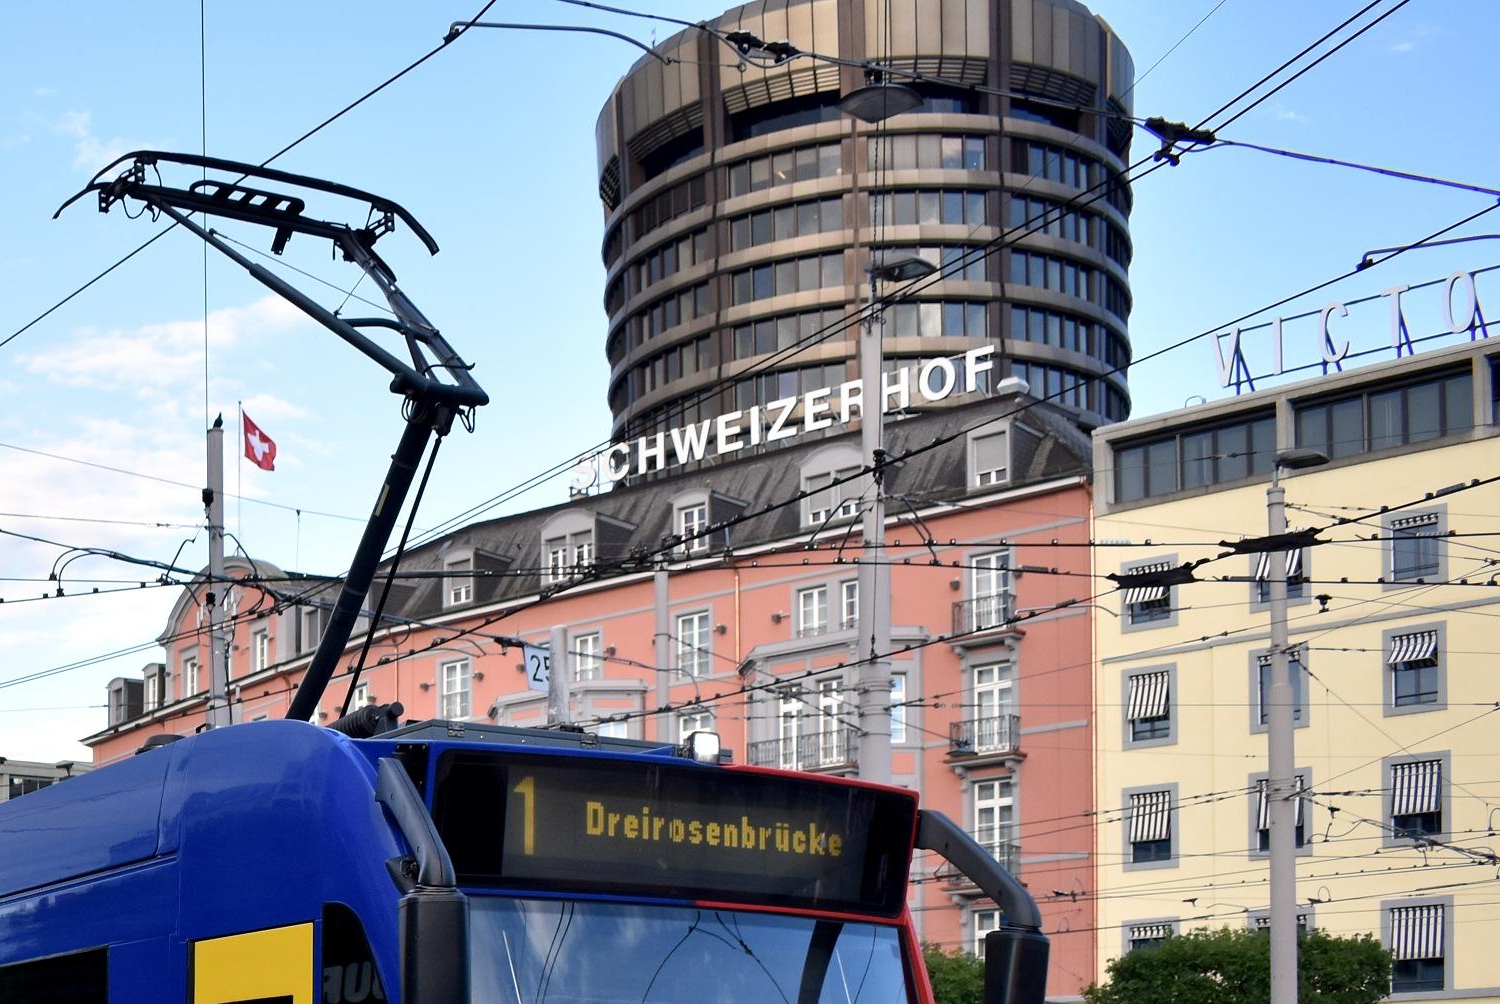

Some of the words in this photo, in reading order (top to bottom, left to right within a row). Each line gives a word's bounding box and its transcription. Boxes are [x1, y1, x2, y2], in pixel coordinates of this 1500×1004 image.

[1210, 271, 1478, 388] VICTO
[570, 345, 995, 490] SCHWEIZERHOF
[513, 776, 534, 856] 1
[586, 800, 842, 857] Dreirosenbrücke
